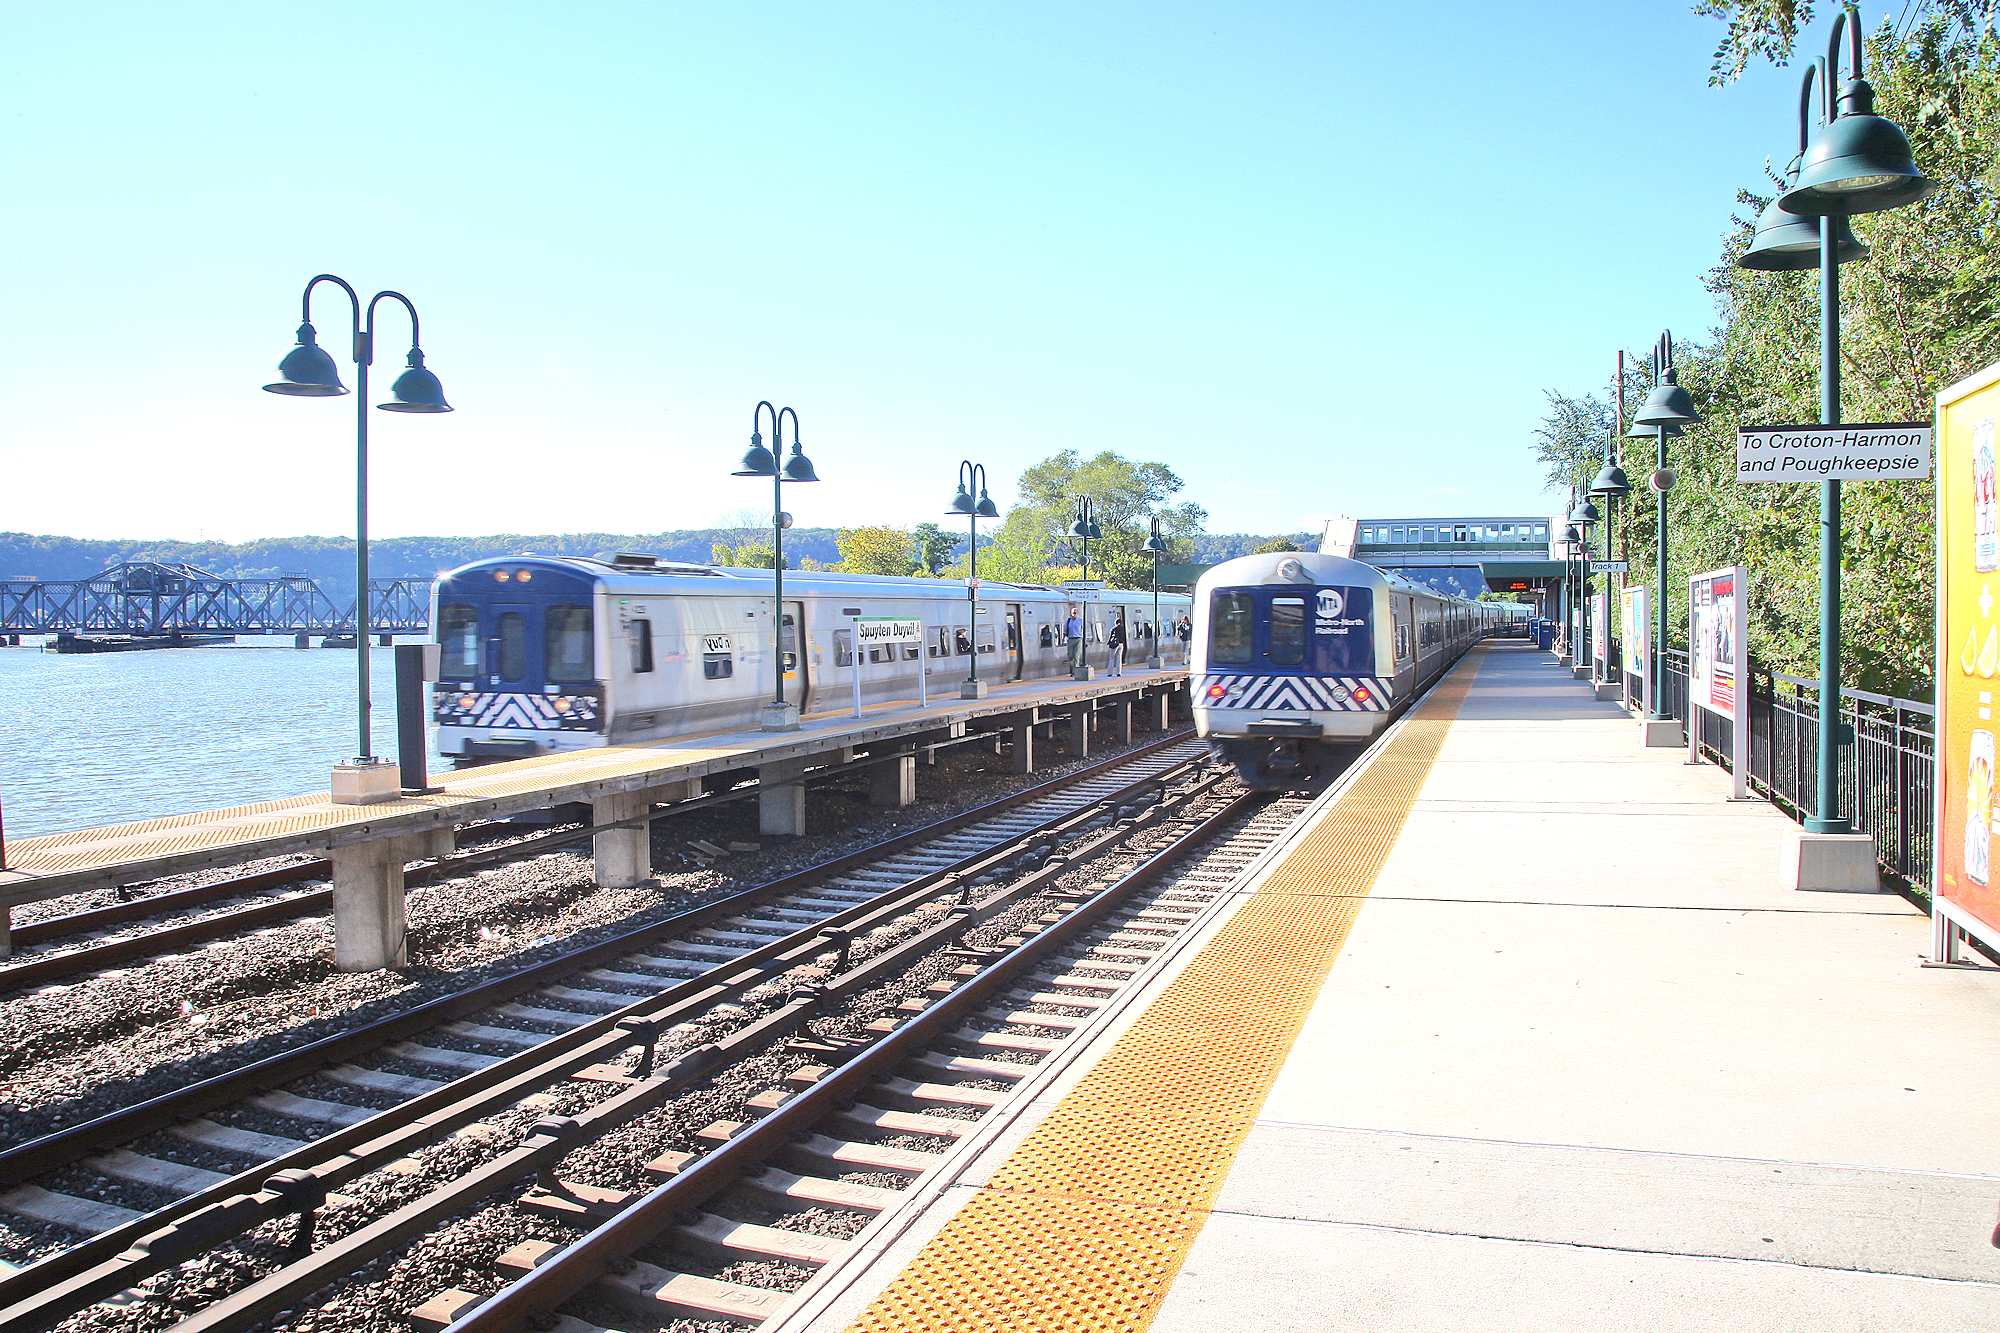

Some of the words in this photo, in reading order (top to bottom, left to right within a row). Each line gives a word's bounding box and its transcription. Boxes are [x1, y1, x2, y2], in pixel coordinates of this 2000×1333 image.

[1741, 434, 1762, 450] To
[1768, 432, 1922, 450] Croton-Harmon
[1740, 456, 1776, 472] and
[1781, 454, 1920, 474] Poughkeepsie
[1591, 562, 1613, 570] Track
[1316, 593, 1340, 614] MTA
[1315, 618, 1365, 626] Metro-North
[1315, 627, 1349, 635] Railroad
[859, 622, 891, 641] Spuyten
[893, 622, 915, 639] Duyvil
